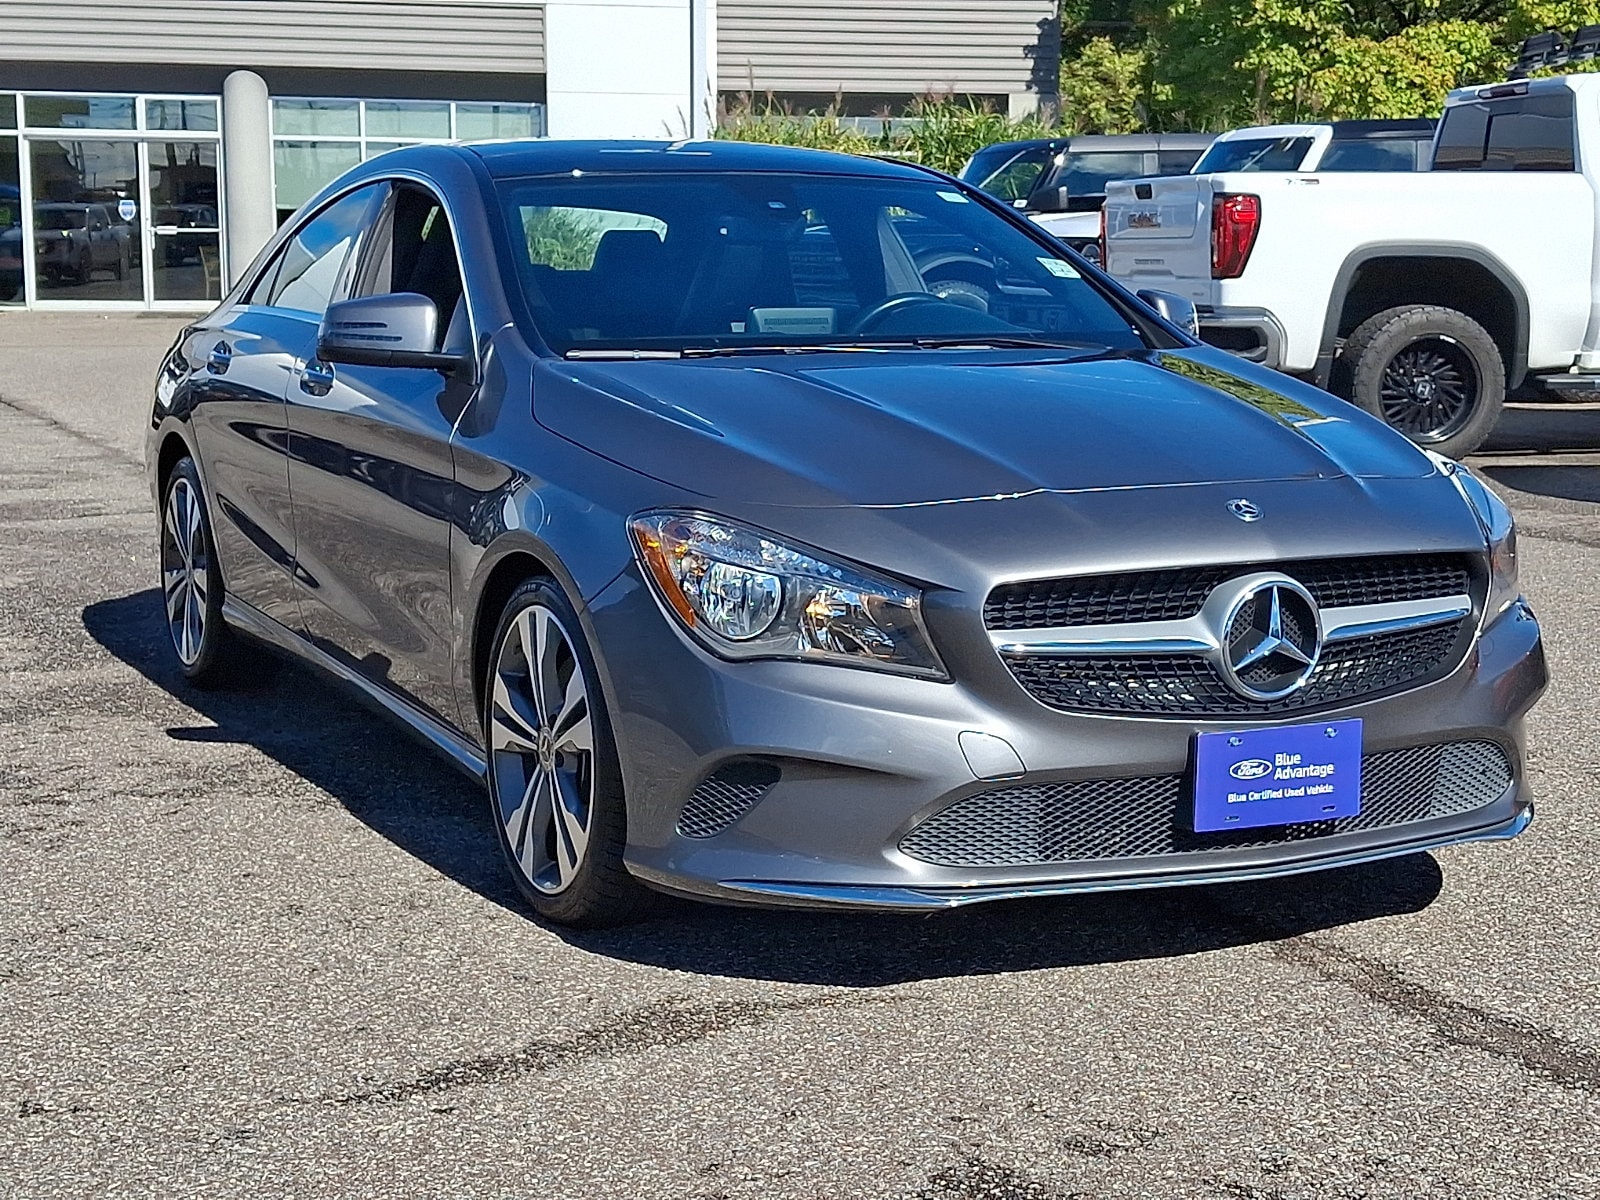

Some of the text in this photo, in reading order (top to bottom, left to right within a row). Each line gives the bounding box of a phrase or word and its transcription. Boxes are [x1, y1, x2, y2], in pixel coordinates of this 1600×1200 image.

[1275, 752, 1302, 766] Blue
[1237, 761, 1265, 776] Ford
[1274, 763, 1335, 780] Advantage
[1227, 783, 1334, 803] Blue Certified Used Vehicle
